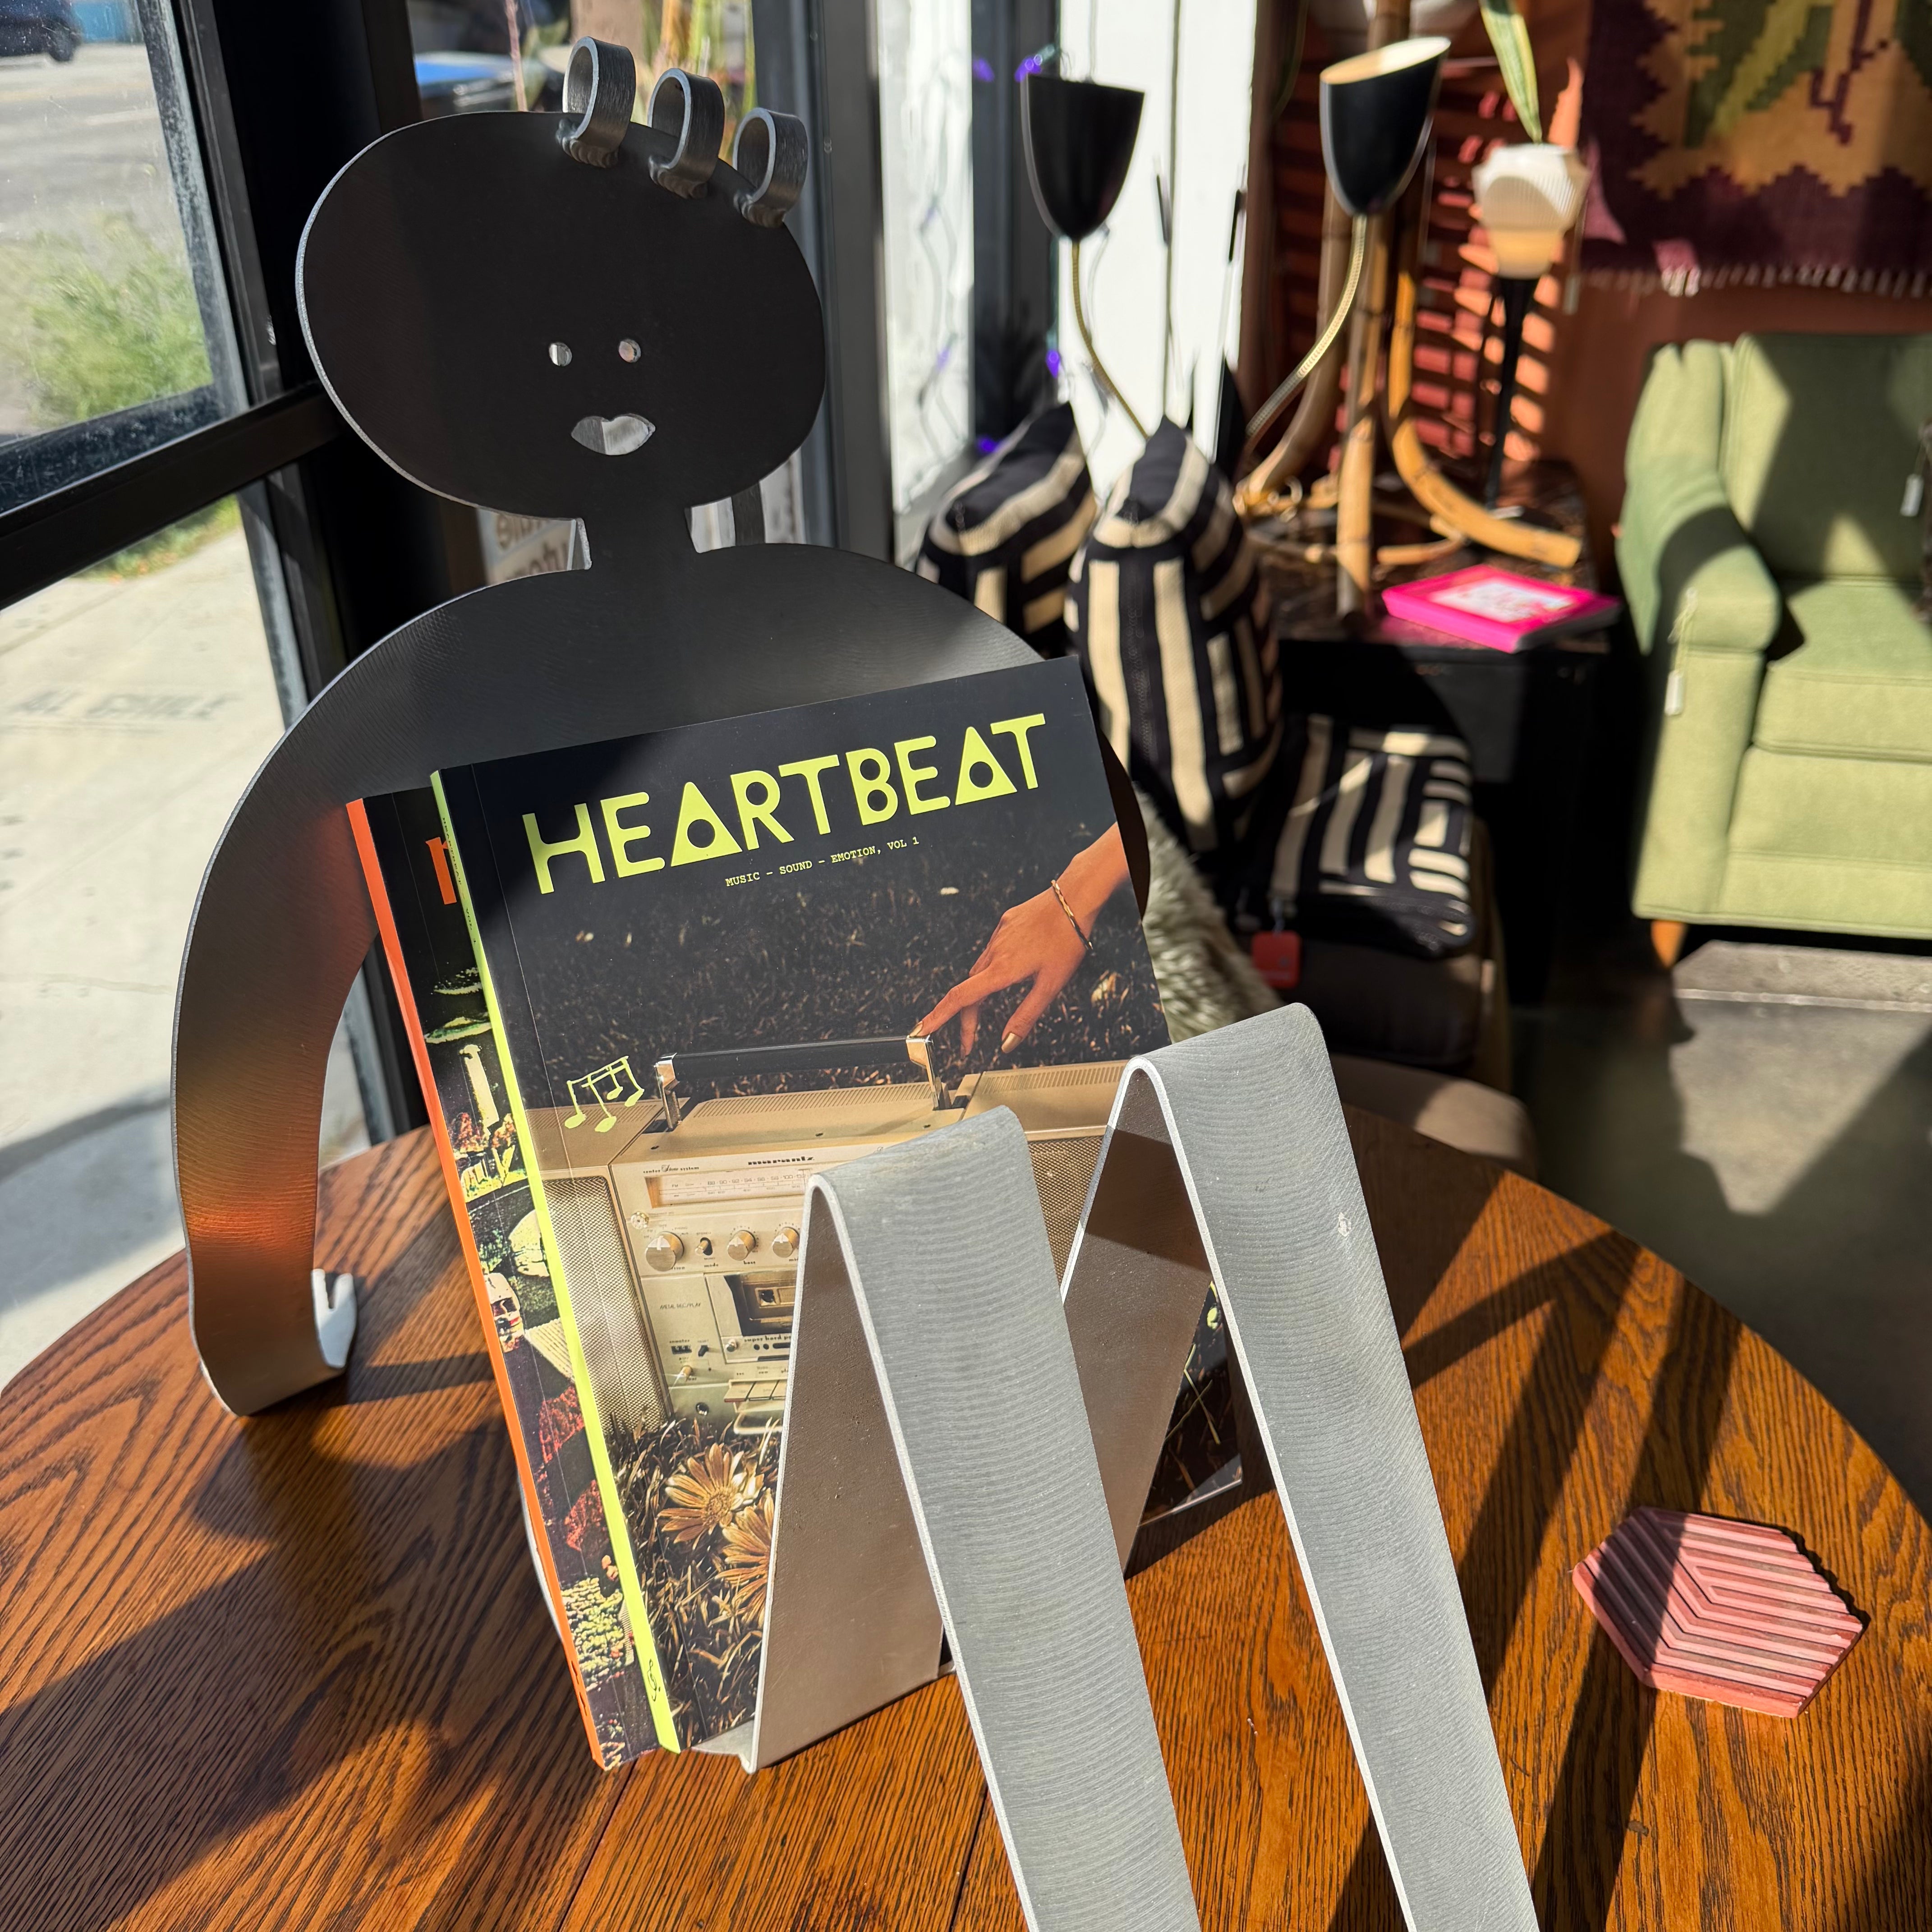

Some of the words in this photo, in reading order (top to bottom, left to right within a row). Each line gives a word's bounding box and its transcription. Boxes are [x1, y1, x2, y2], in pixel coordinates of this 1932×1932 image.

[522, 713, 1046, 895] HEARTBEAT
[442, 817, 461, 885] HEARTBEAT
[725, 872, 760, 887] MUSIC
[779, 860, 813, 875] SOUND
[830, 846, 881, 864] EMOTION,
[887, 840, 906, 850] VOL
[912, 837, 919, 845] 1
